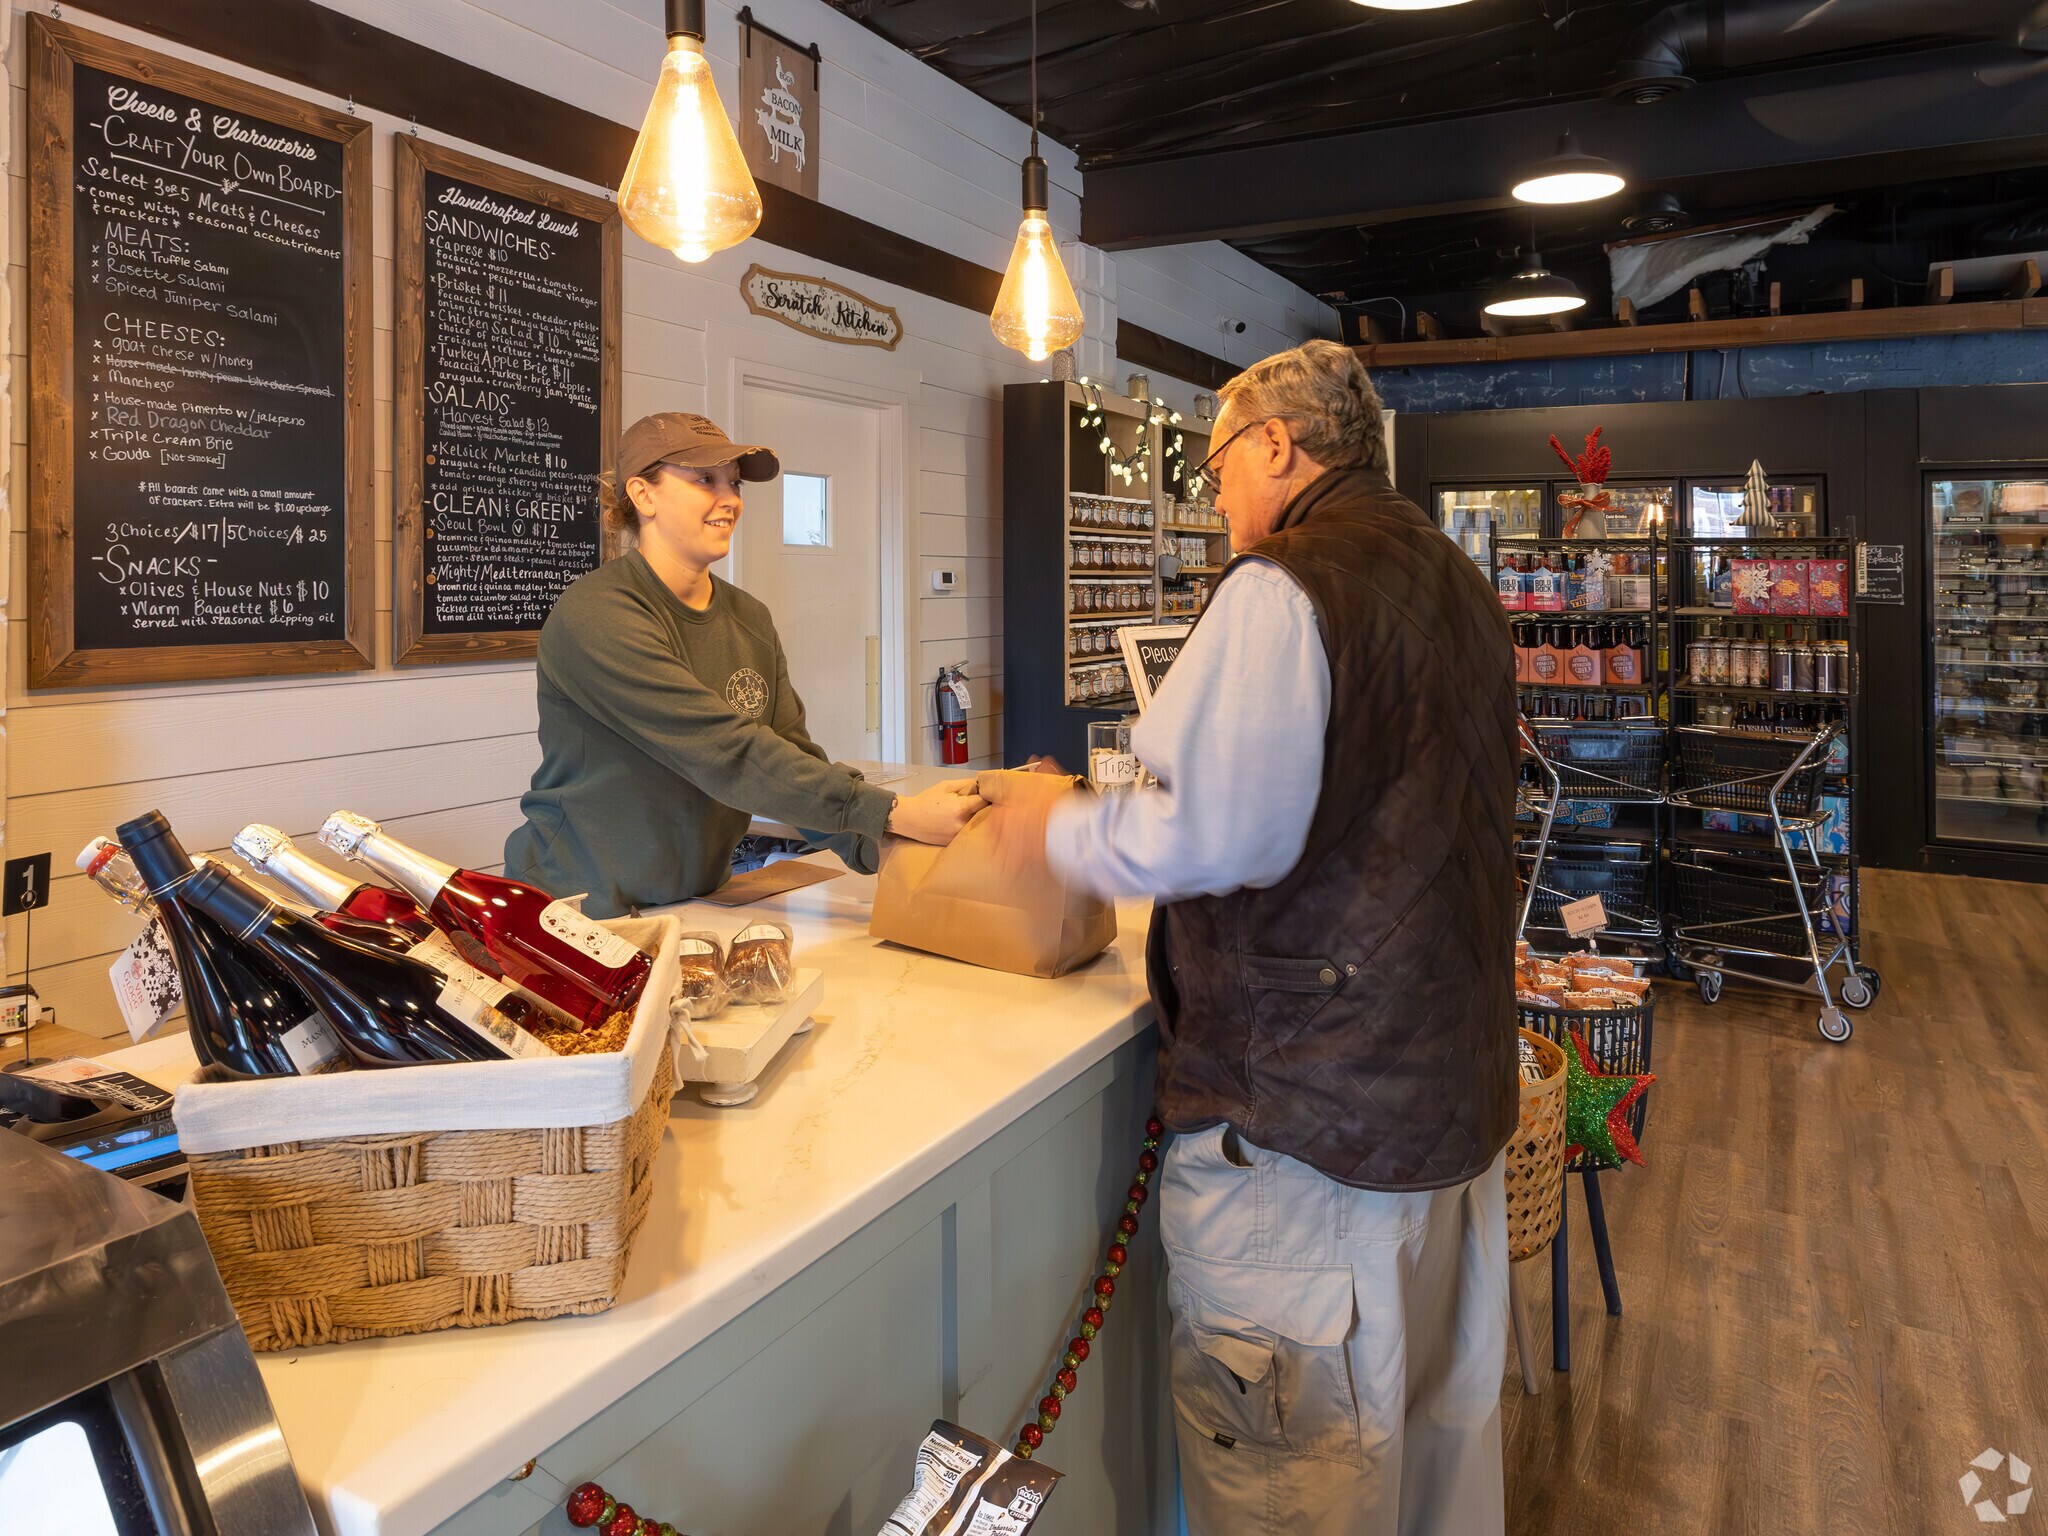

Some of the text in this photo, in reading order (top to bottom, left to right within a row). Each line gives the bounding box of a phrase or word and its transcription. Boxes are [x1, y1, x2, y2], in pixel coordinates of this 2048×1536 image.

[771, 93, 801, 116] BACON
[108, 86, 317, 161] Cheese & Charcuterie
[770, 125, 802, 153] MILK
[81, 158, 320, 239] Select Meats Cheeses
[438, 187, 579, 238] Handcrafted Lunch
[105, 222, 189, 253] MEATS:
[144, 201, 341, 258] with seasonal accoutriments
[436, 235, 483, 258] Caprese
[107, 242, 229, 275] Black Truffle Salami
[436, 250, 481, 267] focaccia
[107, 258, 226, 293] Rosette Salami
[438, 273, 482, 296] Brisket
[105, 277, 278, 326] Spiced Juniper Salami
[489, 272, 598, 308] pesto vinegar
[438, 300, 549, 331] onion straws arugula
[490, 302, 568, 325] brisket cheddar
[766, 282, 888, 337] Scratch Kitchen
[104, 313, 225, 347] CHEESES:
[438, 309, 533, 341] Chicken Salad
[439, 323, 528, 349] choice of original
[438, 334, 575, 367] croissant lettuce tomato
[438, 342, 548, 376] Turkey Apple Brie
[109, 370, 174, 392] Manchego
[438, 358, 585, 395] focaccia brie apple
[439, 372, 483, 385] arugula
[107, 407, 272, 439] Red Dragon Cheddar
[442, 406, 524, 428] Harvest Salad
[100, 428, 233, 451] Triple Brie
[103, 446, 151, 461] Gouda
[439, 442, 540, 464] Kelsick Market
[440, 459, 547, 477] arugula feta candied
[439, 470, 592, 495] tomato orange vinaigrette
[260, 490, 315, 500] small amount
[209, 500, 331, 516] Extra will be upcharge
[436, 513, 506, 533] Seoul Bowl
[490, 545, 533, 554] edamame
[437, 554, 593, 569] carrot peanut dressing
[482, 564, 560, 582] Mediterranean
[130, 582, 292, 598] Olives House Nuts
[1500, 579, 1516, 587] BOLD
[1534, 579, 1552, 587] BOLD
[132, 600, 261, 618] Warm Baguette
[182, 613, 335, 626] with dipping oil
[436, 604, 468, 616] pickled
[488, 613, 542, 624] vinaigrette
[1737, 724, 1771, 733] ELYSIAN
[22, 864, 35, 901] 1
[135, 983, 145, 1004] VIN
[930, 1438, 972, 1465] Nutrition Facts
[943, 1470, 957, 1481] 300
[1017, 1499, 1031, 1512] 11
[1019, 1489, 1040, 1503] ROUTE
[1009, 1511, 1029, 1522] CHIPS
